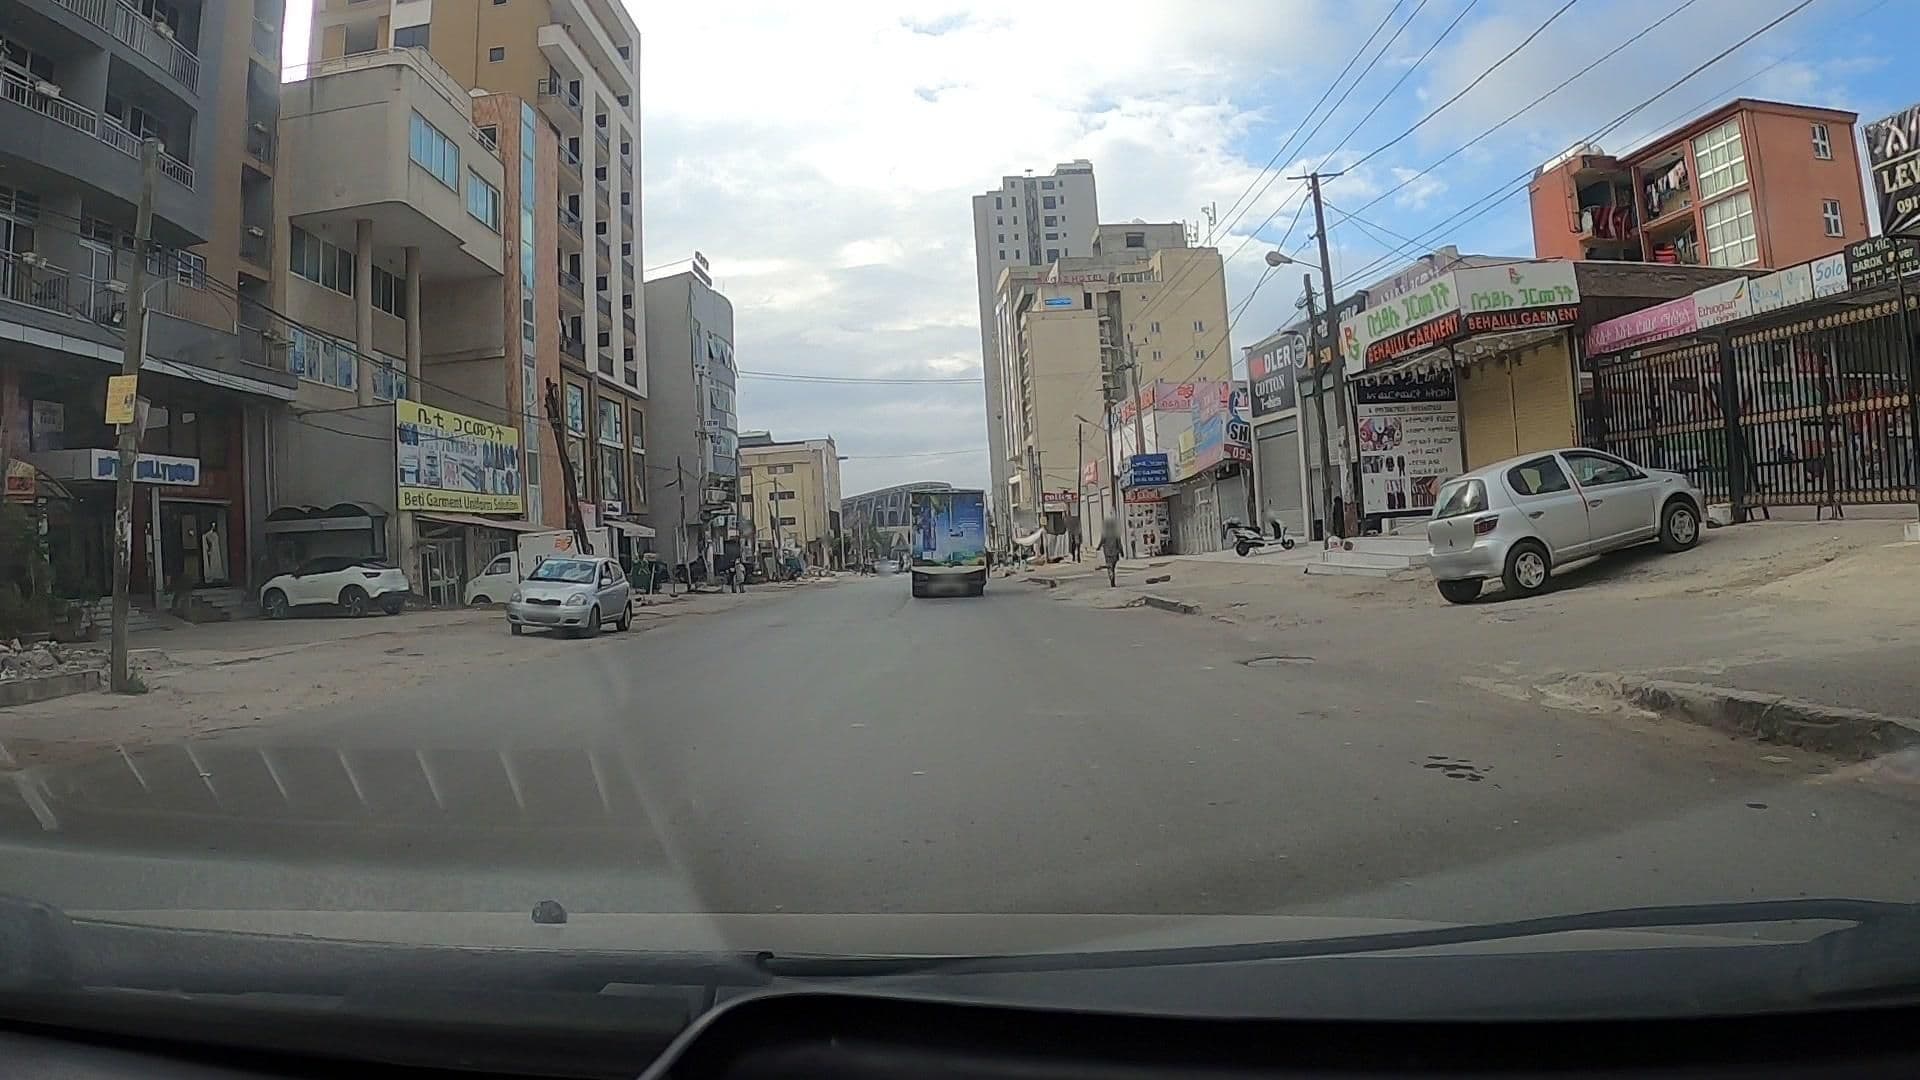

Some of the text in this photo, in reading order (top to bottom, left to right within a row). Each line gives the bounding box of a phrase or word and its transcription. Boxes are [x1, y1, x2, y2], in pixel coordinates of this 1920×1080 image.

[1897, 197, 1920, 213] 091
[1815, 259, 1843, 281] Solo
[1468, 307, 1578, 330] BEHAILU GARMENT
[1368, 334, 1406, 364] BEHAILU
[1408, 313, 1459, 350] GARMENT
[1255, 374, 1285, 397] COTTON
[453, 417, 505, 441] ጋርመንት
[1230, 421, 1250, 442] SH
[404, 491, 425, 507] Beti
[426, 493, 462, 508] Garment
